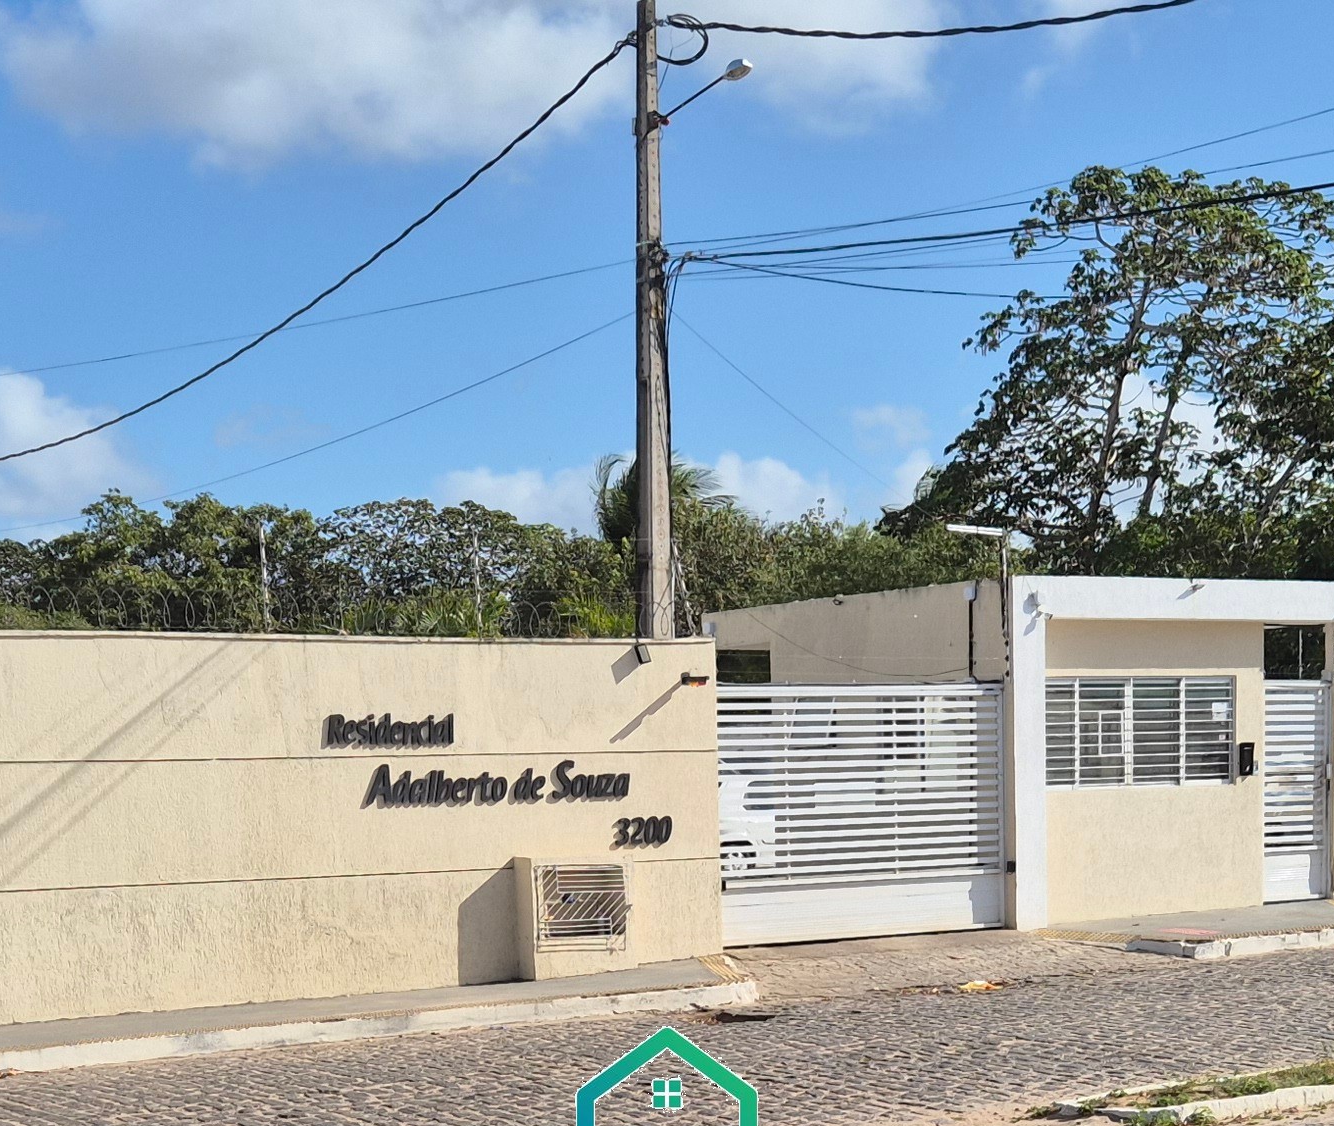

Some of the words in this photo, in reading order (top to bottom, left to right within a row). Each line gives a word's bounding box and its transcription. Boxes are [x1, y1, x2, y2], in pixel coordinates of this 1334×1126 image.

[325, 713, 454, 747] Residencial
[365, 764, 508, 806] Adalberto
[515, 767, 546, 800] de
[555, 759, 631, 801] Souza
[614, 815, 673, 847] 3200
